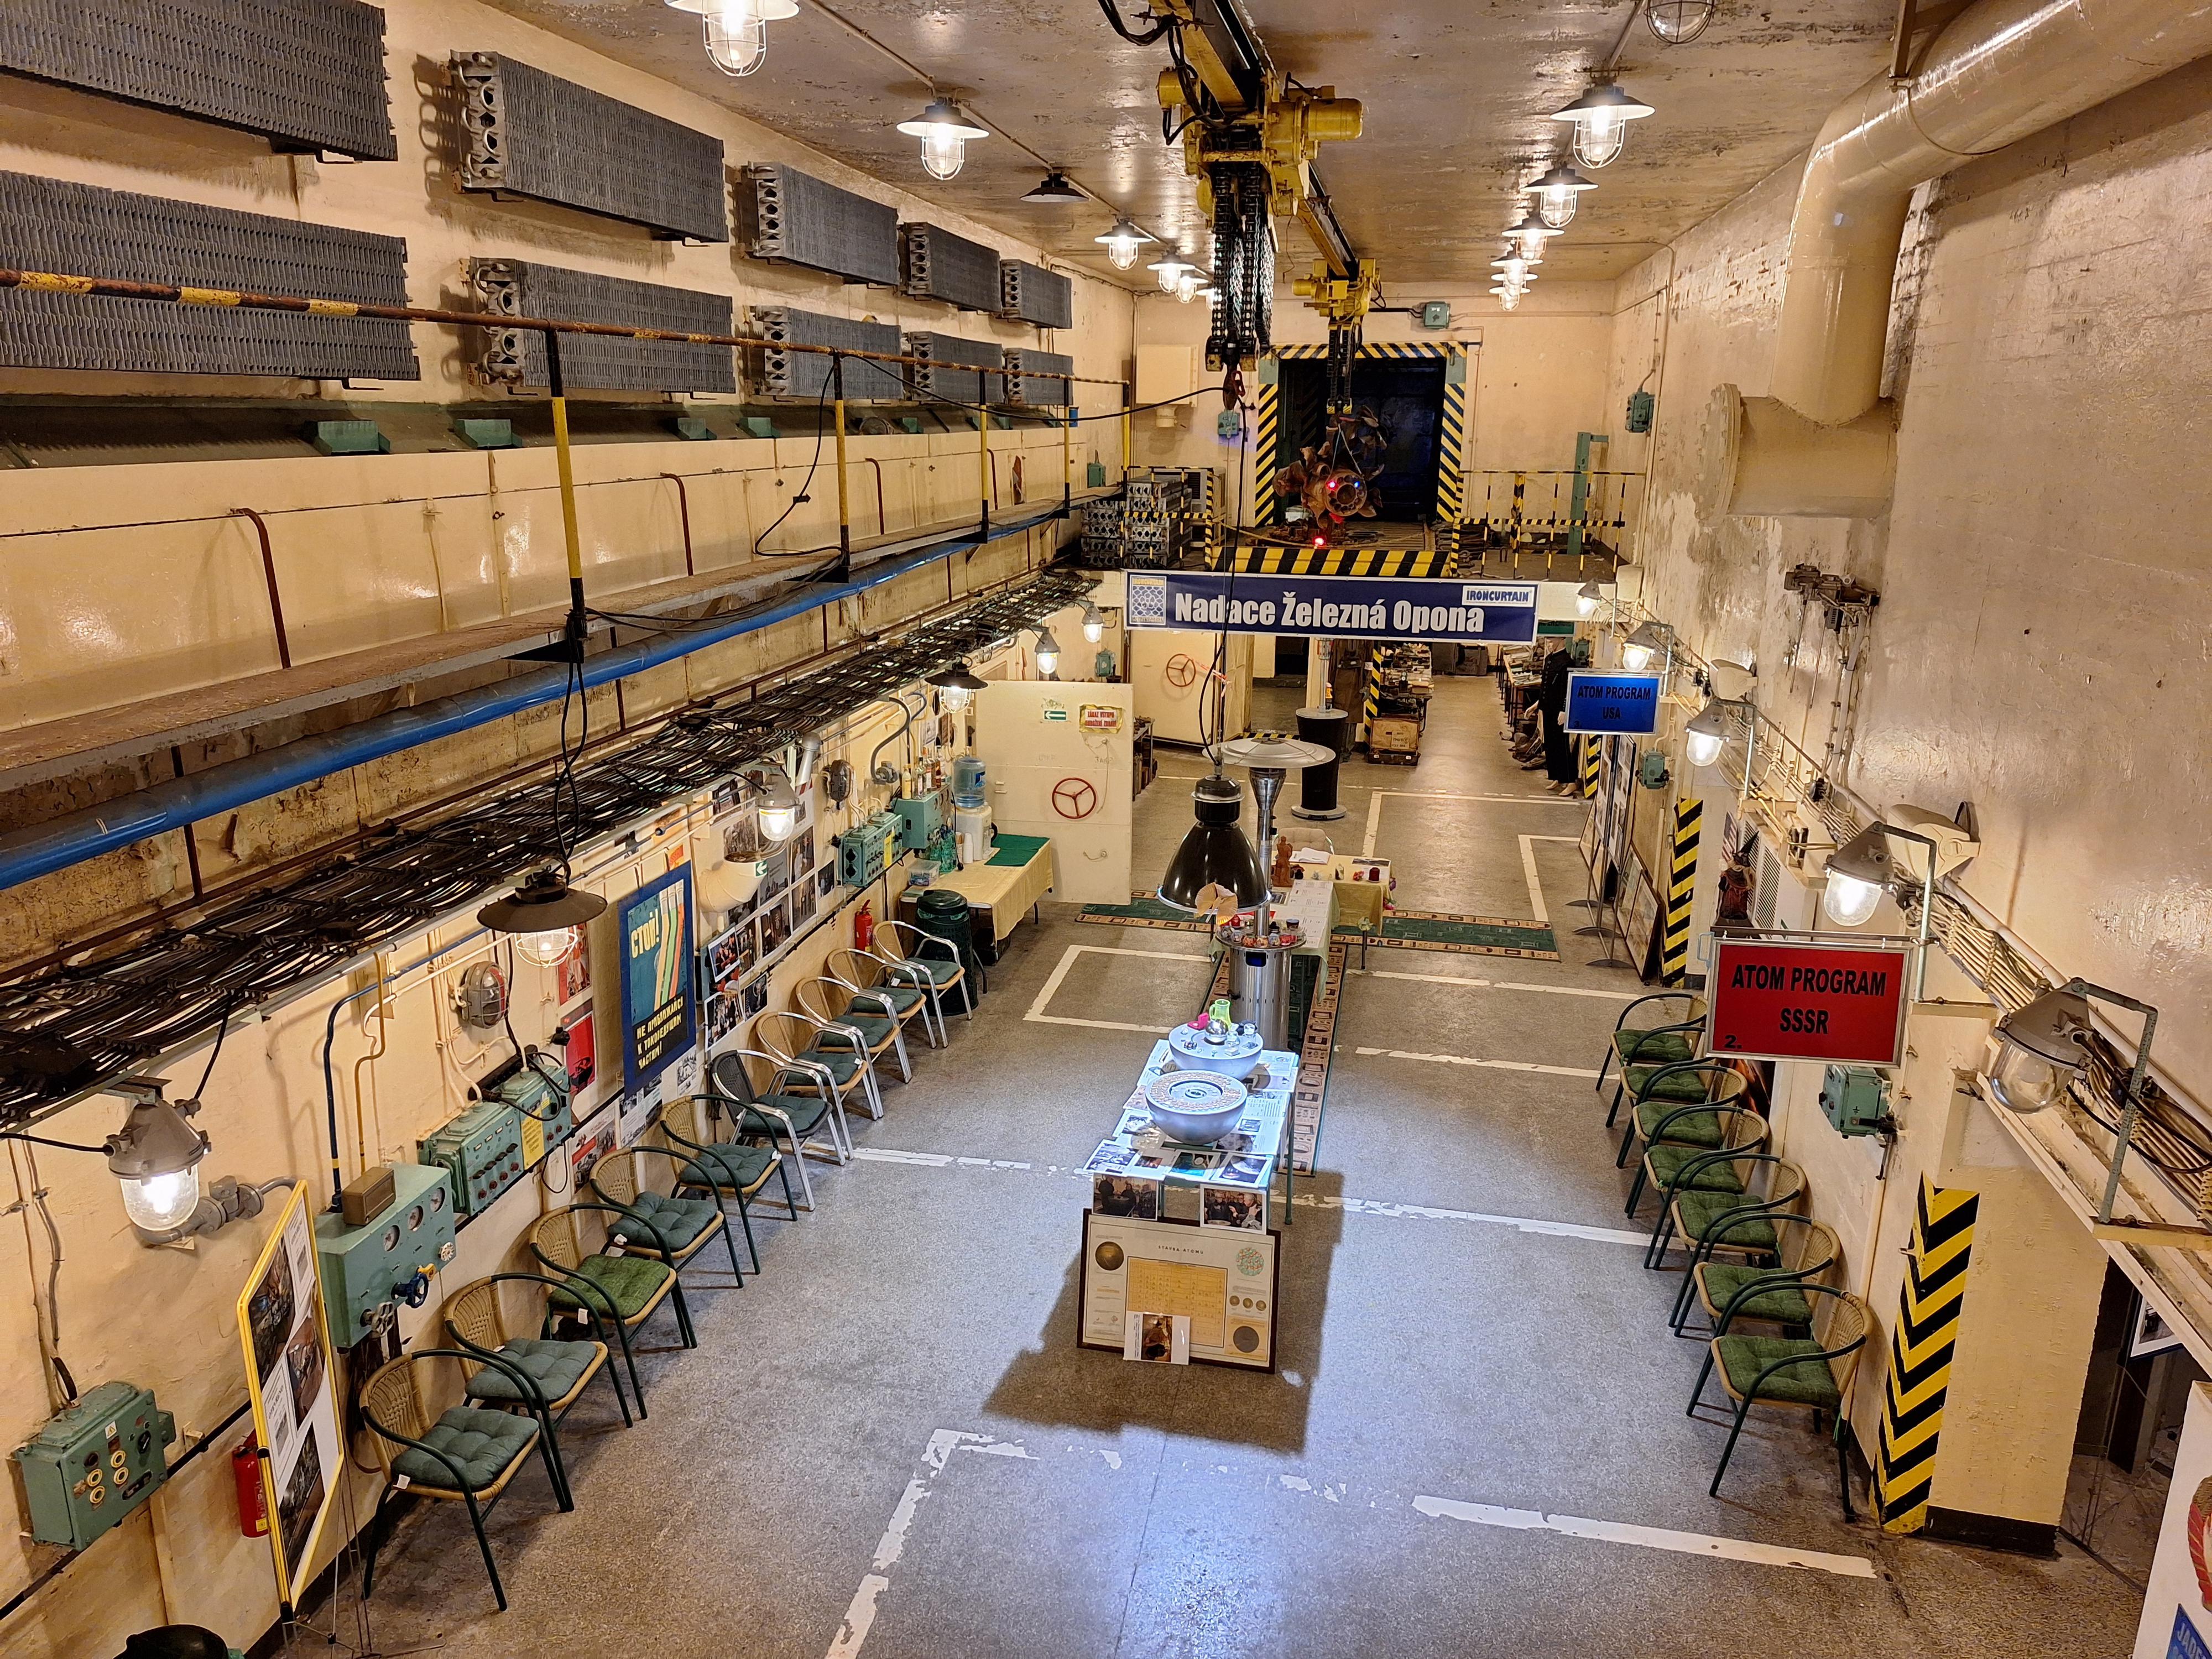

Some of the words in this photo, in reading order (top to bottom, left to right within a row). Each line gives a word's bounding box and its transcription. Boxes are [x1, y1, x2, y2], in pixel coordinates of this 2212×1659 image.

[1466, 590, 1529, 602] IRONCURTAIN
[1175, 592, 1276, 625] Nadace
[1280, 591, 1386, 630] Železná
[1393, 599, 1485, 634] Opona
[1577, 685, 1603, 698] ATOM
[1605, 686, 1651, 701] PROGRAM
[1602, 707, 1621, 719] USA
[631, 908, 660, 958] СТОЙ!
[1731, 964, 1786, 990] ATOM
[1790, 967, 1887, 997] PROGRAM
[1779, 1008, 1830, 1035] SSSR
[637, 1025, 646, 1040] НЕ
[637, 1042, 643, 1055] К
[1723, 1034, 1743, 1049] 2.
